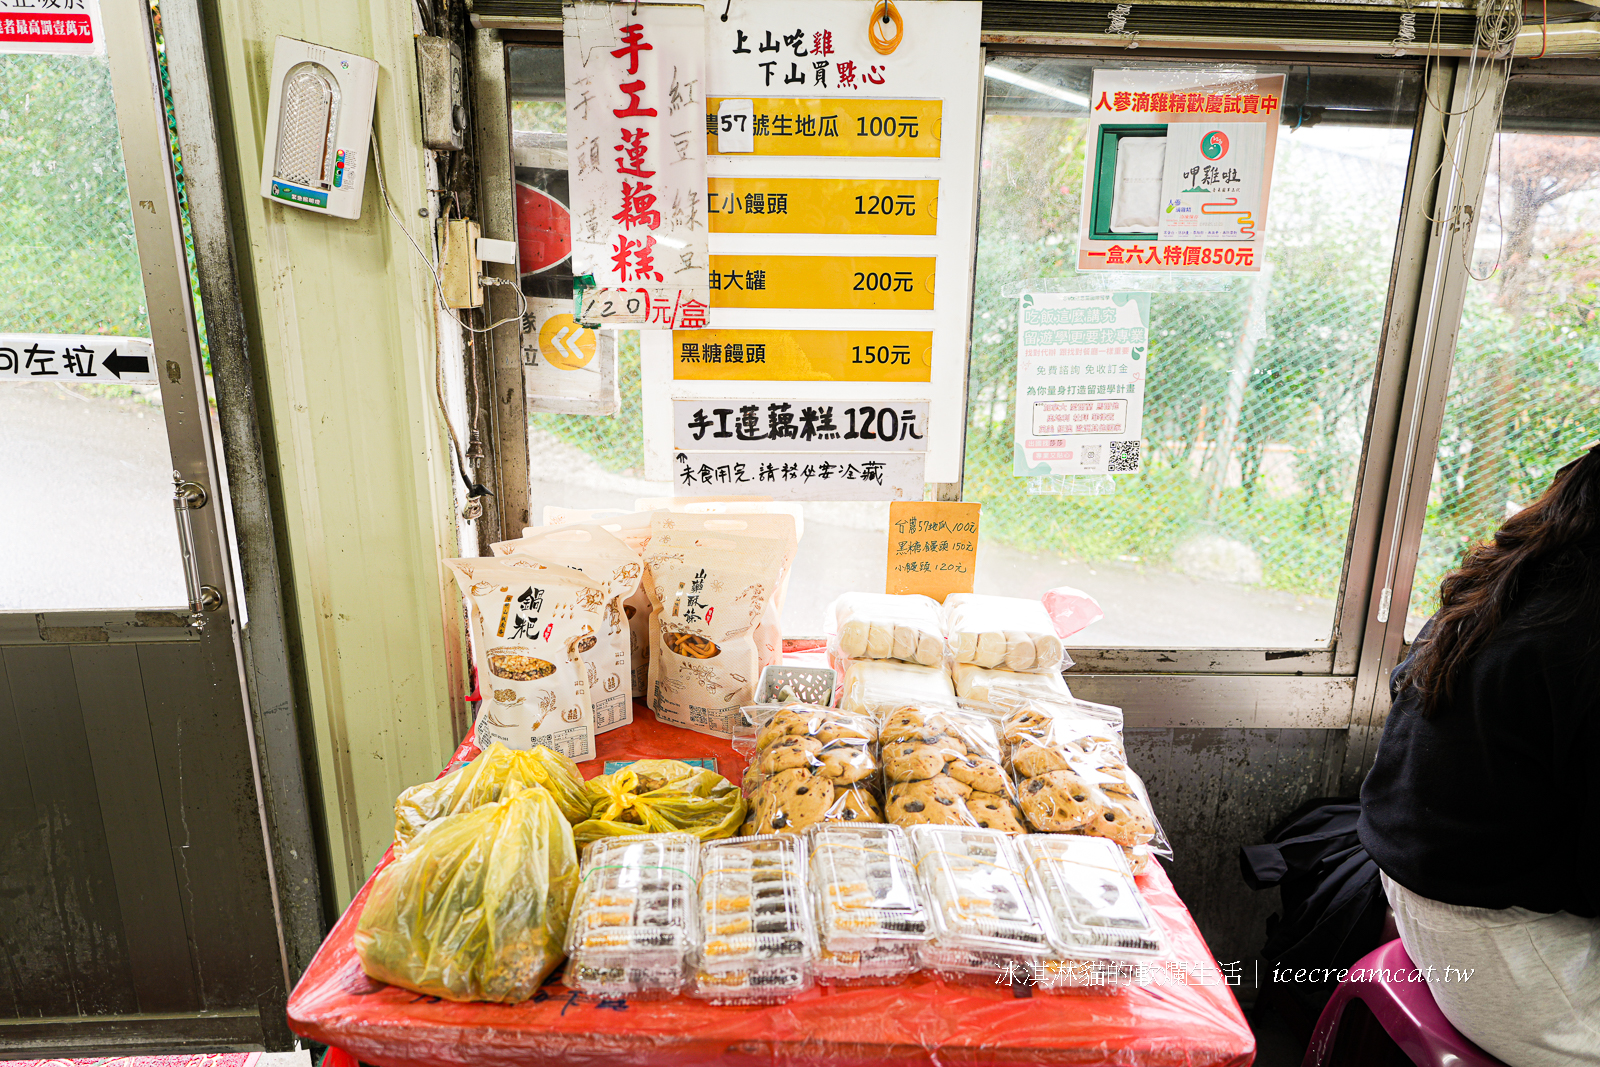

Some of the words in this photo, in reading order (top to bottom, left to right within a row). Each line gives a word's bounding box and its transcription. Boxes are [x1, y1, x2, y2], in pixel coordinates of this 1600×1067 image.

[0, 19, 91, 36] 者最高罰壹萬元
[732, 29, 834, 57] 上山吃雞
[758, 60, 886, 90] 下山買點心
[856, 115, 919, 138] 100元
[610, 24, 664, 283] 手工蓮藕糕
[854, 194, 916, 216] 120元
[1087, 245, 1254, 267] 一盒六入特價850元
[853, 271, 914, 292] 200元
[680, 343, 766, 364] 黑糖饅頭
[851, 345, 911, 365] 150元
